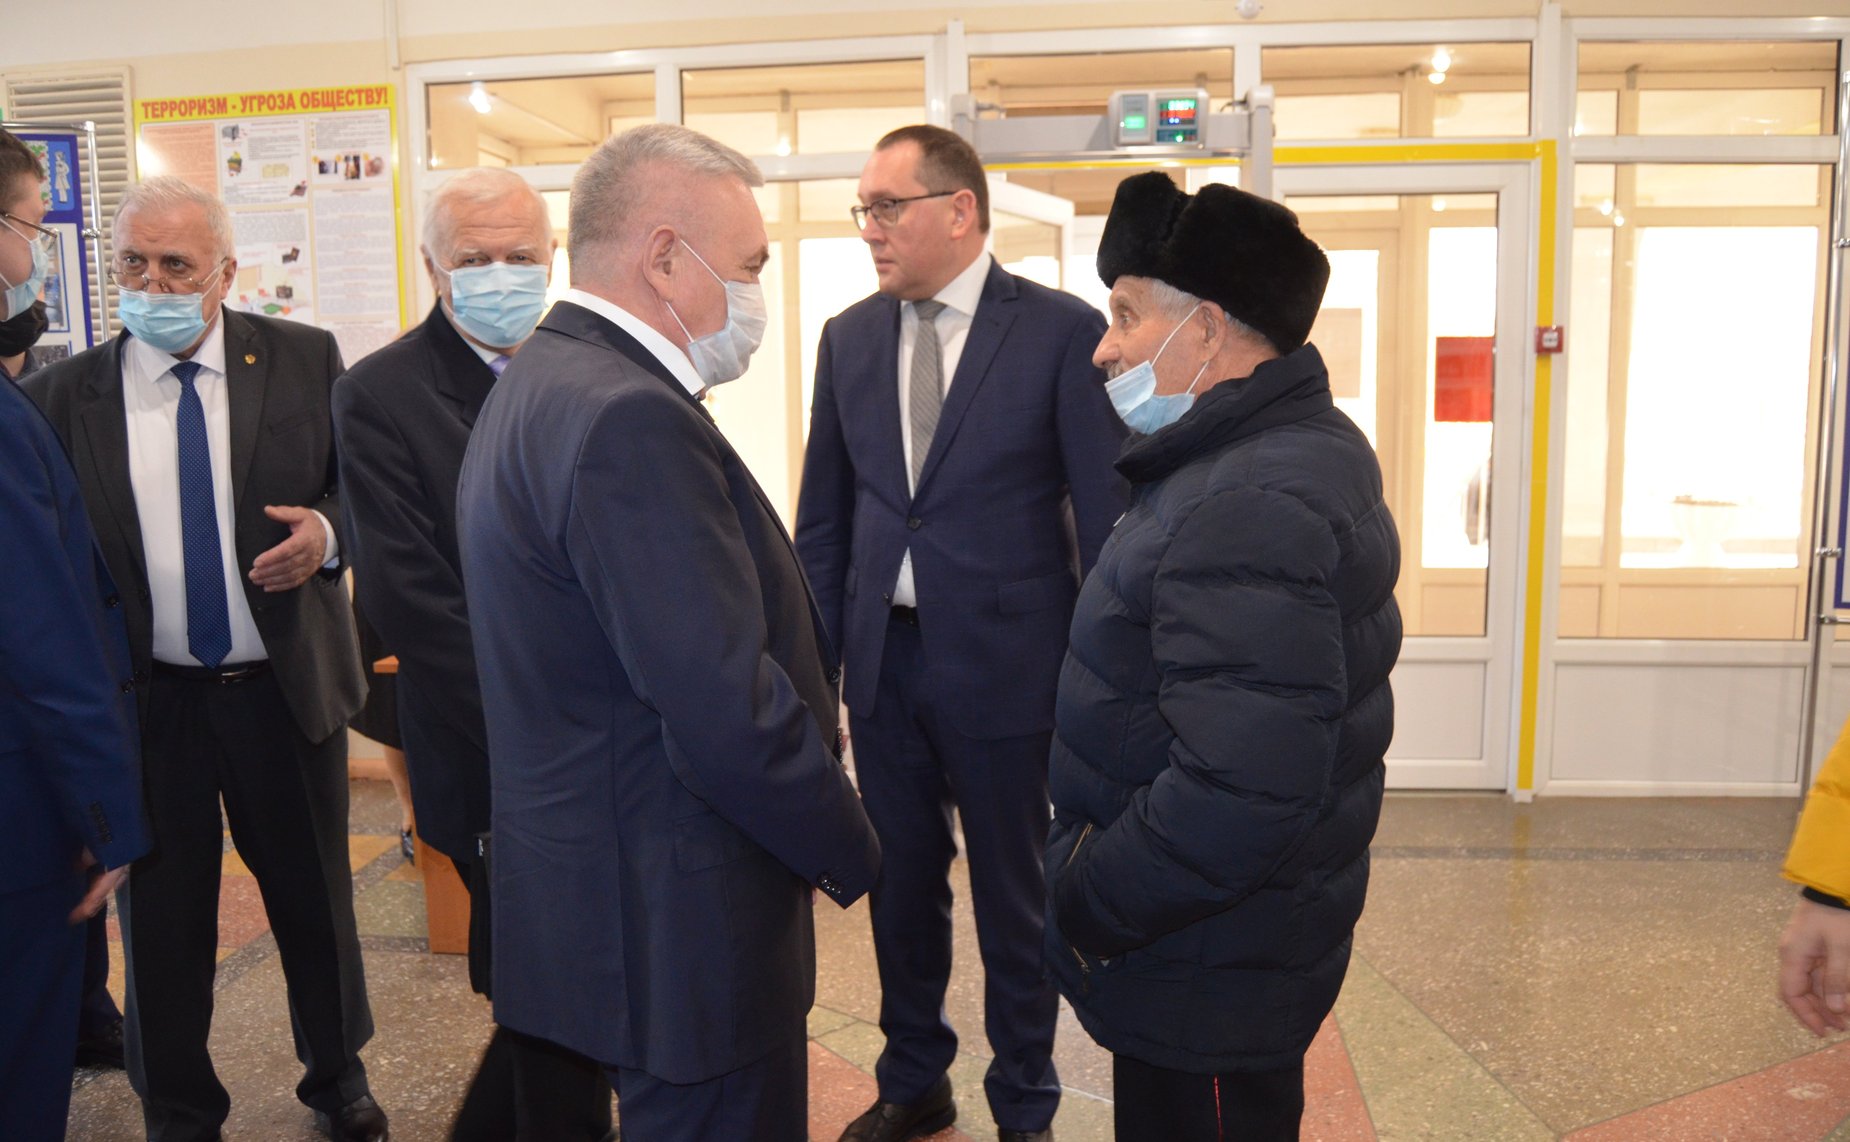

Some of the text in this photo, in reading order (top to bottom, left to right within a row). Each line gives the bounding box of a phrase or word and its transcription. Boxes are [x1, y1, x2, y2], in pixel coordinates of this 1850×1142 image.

[141, 97, 228, 119] ТЕРРОРИЗМ
[240, 92, 296, 114] УГРОЗА
[299, 87, 389, 112] ОБЩЕСТВУ!
